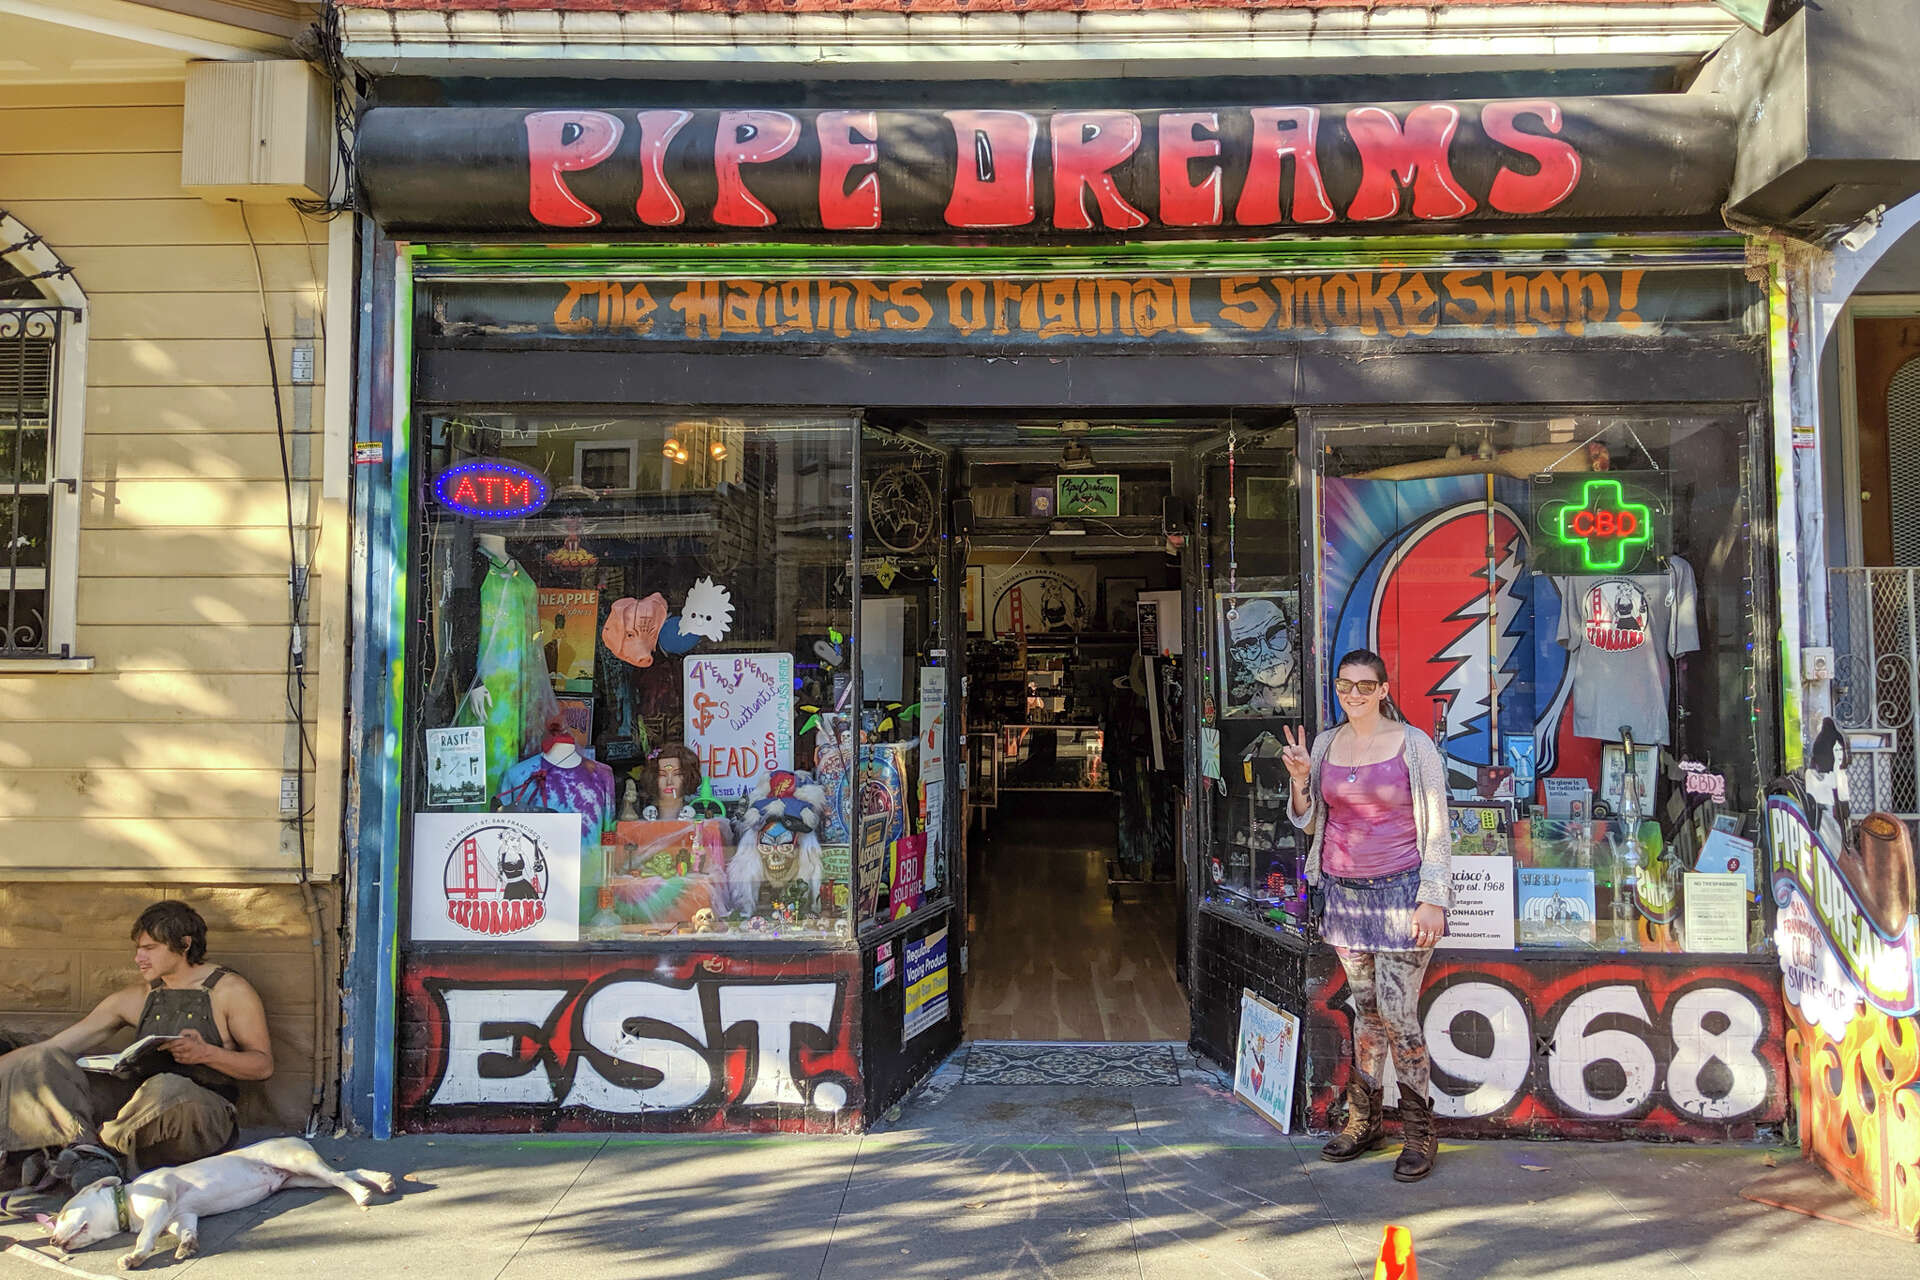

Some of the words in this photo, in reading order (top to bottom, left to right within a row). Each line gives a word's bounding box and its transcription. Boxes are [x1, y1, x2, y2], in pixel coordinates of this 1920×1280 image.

[524, 109, 881, 231] PIPE
[942, 101, 1583, 231] DREAMS
[553, 280, 657, 335] The
[669, 279, 934, 338] Haights
[947, 278, 1211, 339] Original
[453, 476, 530, 505] ATM
[1573, 511, 1638, 537] CBD
[537, 592, 596, 606] NEAPPLE
[764, 732, 779, 771] SHO
[1772, 808, 1814, 892] PIPE
[900, 857, 918, 885] CBD
[894, 883, 909, 904] SOLD
[1483, 882, 1505, 891] 1968
[925, 952, 948, 972] Products
[429, 980, 847, 1114] EST.
